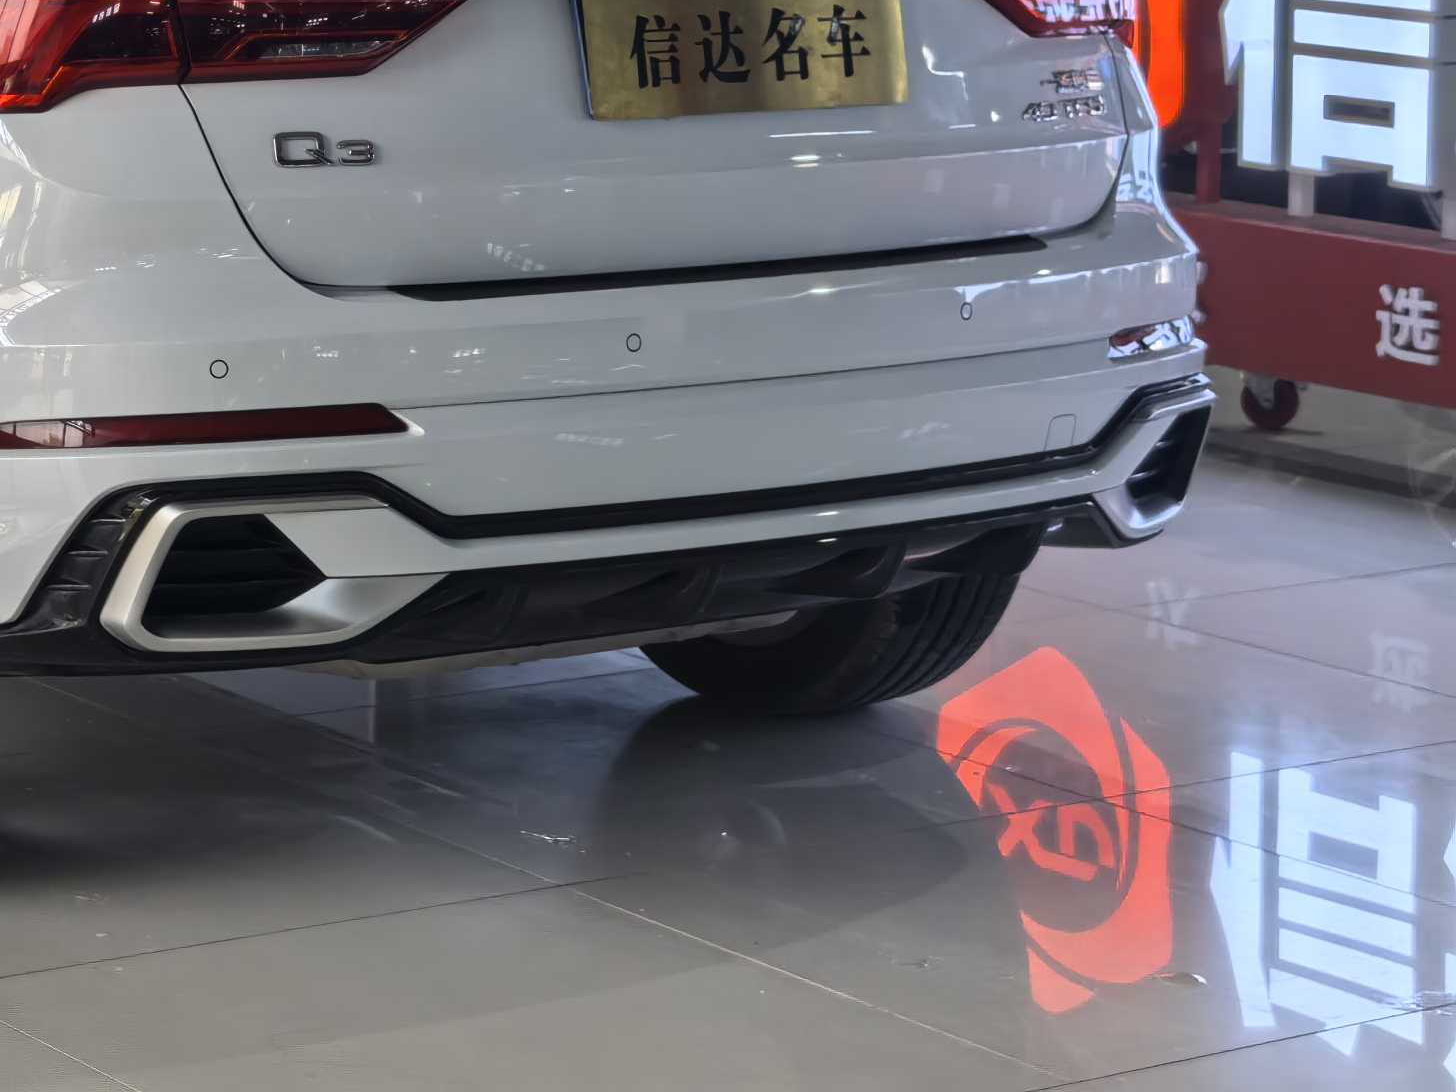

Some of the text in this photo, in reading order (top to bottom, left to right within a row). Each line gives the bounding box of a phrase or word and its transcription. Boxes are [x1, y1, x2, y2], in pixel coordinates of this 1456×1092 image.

[630, 4, 871, 88] 信达名车
[272, 131, 375, 168] Q3
[1376, 284, 1440, 366] 选
